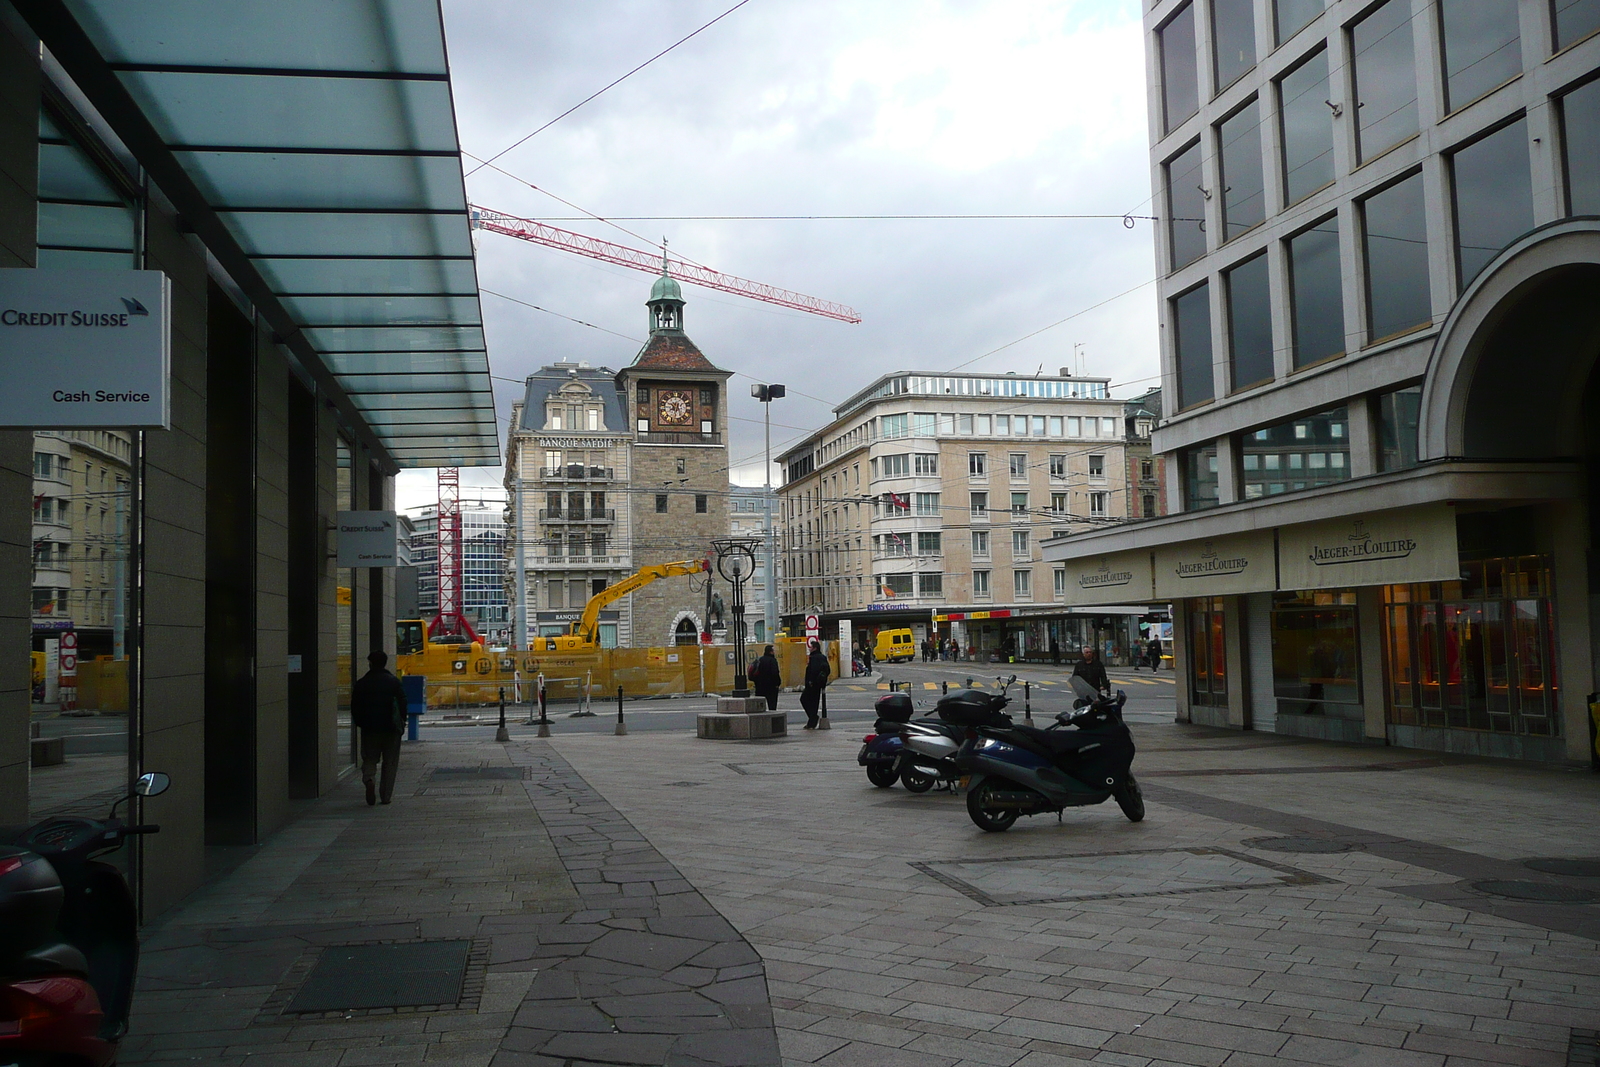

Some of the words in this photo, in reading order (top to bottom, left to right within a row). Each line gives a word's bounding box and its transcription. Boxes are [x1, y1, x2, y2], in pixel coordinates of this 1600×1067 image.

[1, 309, 69, 326] CREDIT
[71, 310, 129, 327] SUISSE
[52, 390, 90, 402] Cash
[95, 390, 150, 402] Service
[539, 439, 579, 448] BANQUE
[886, 602, 910, 611] Coutts
